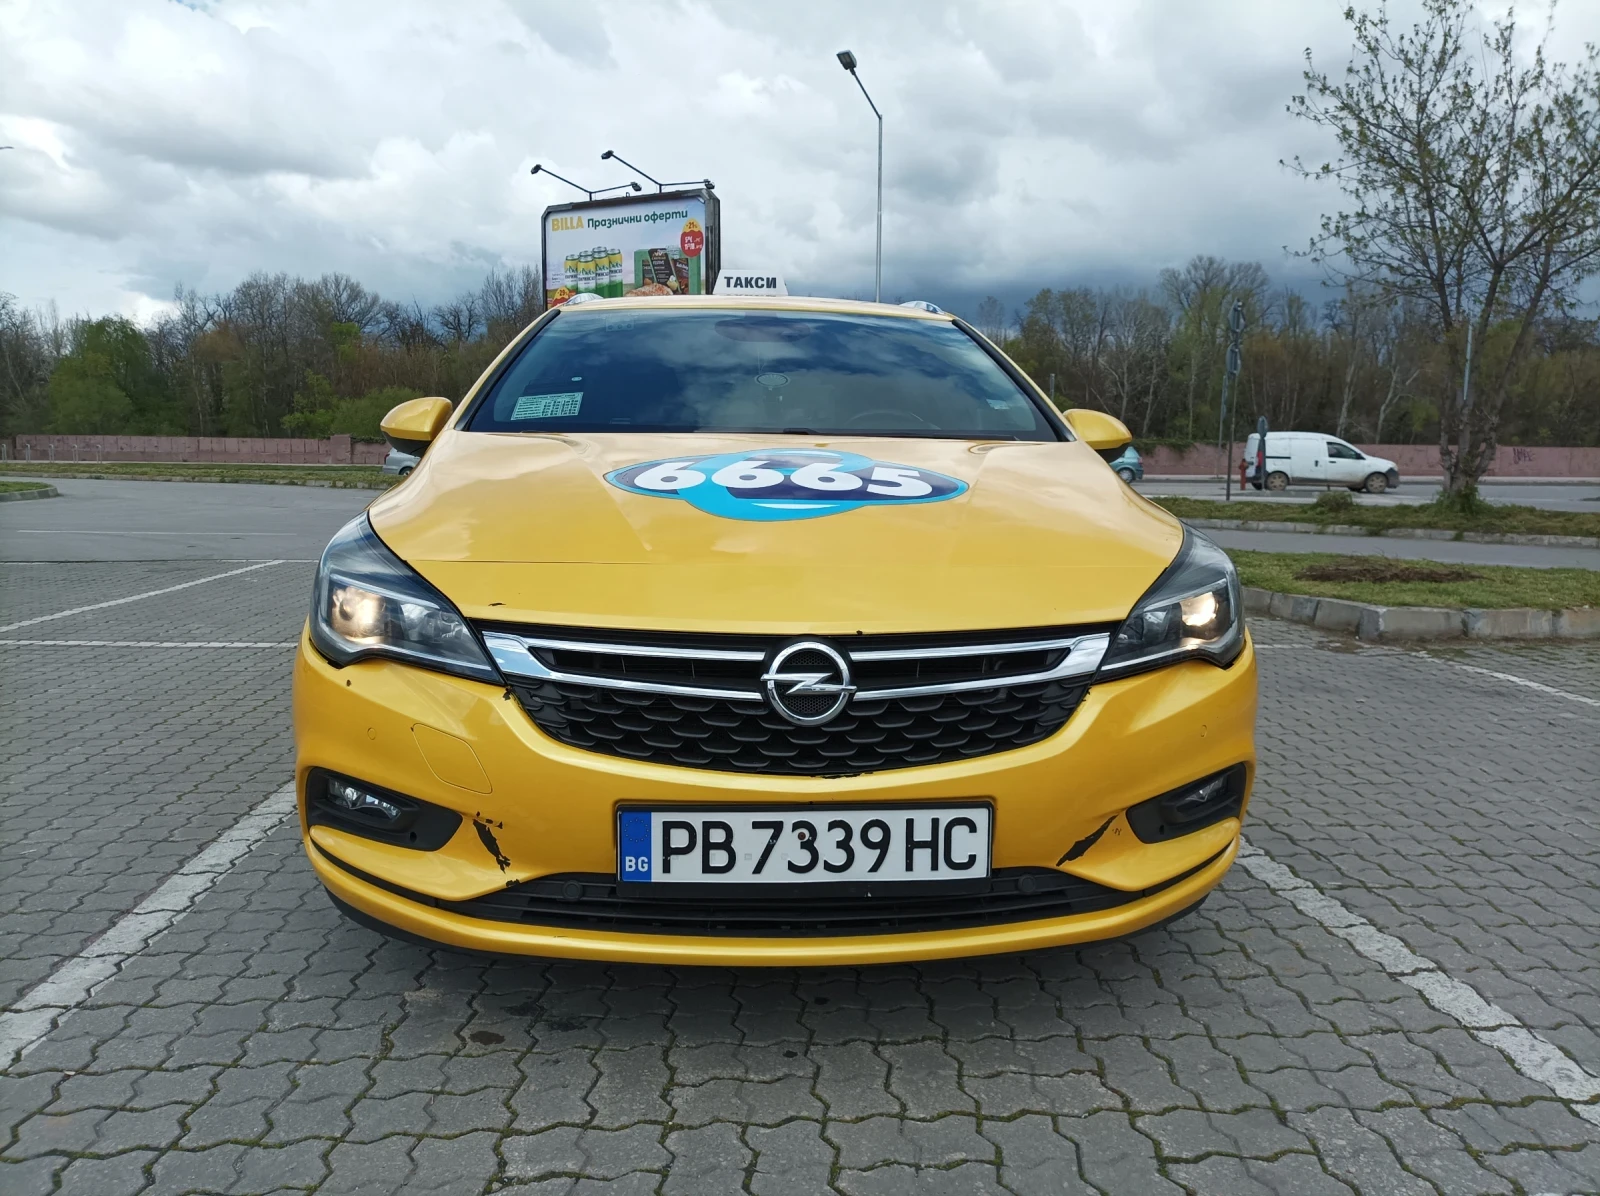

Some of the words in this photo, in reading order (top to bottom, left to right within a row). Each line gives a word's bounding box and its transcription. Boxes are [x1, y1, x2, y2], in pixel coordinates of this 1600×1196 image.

[551, 216, 584, 231] BILLA
[587, 213, 642, 230] Празнични
[643, 210, 688, 224] оферти
[724, 276, 777, 289] ТАКСИ
[633, 460, 933, 497] 6665
[662, 819, 737, 875] PB
[751, 818, 892, 875] 7339
[905, 816, 978, 873] HC
[625, 856, 649, 873] BG
